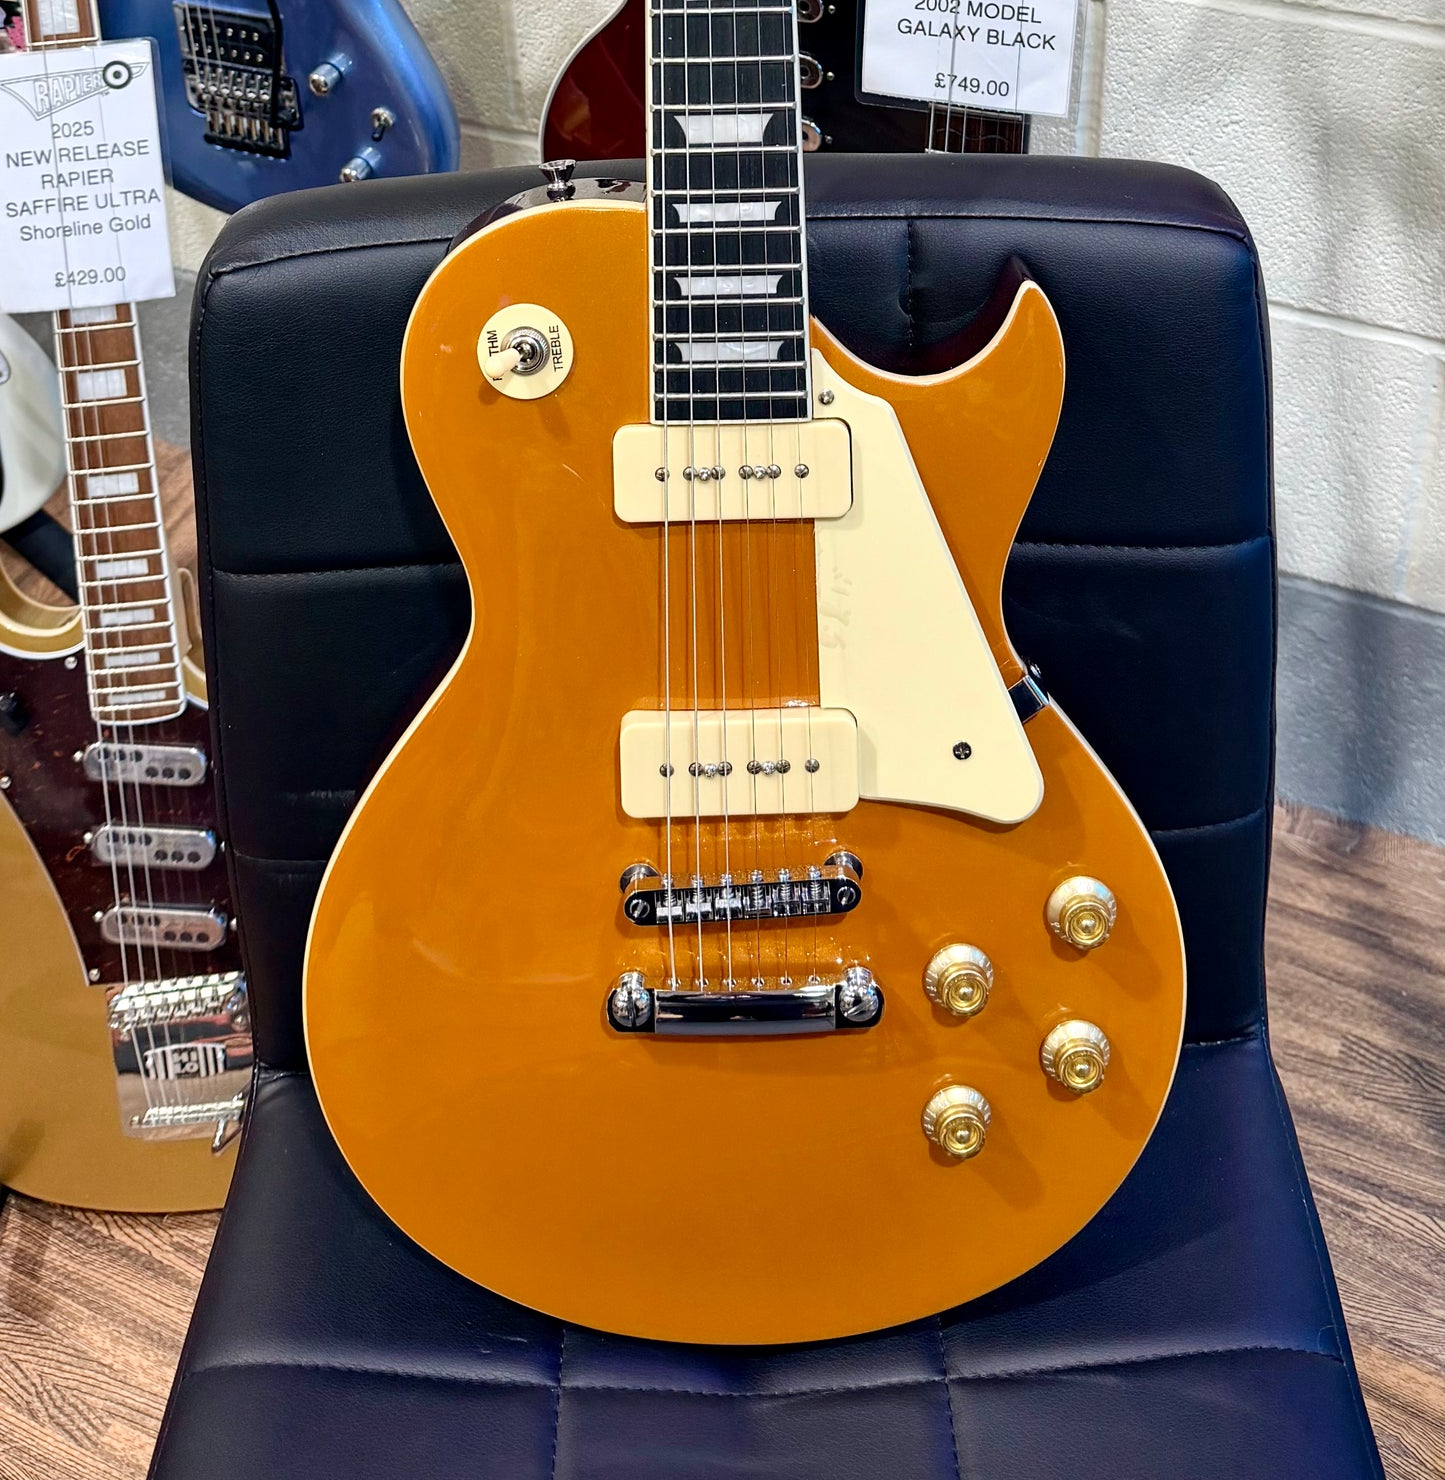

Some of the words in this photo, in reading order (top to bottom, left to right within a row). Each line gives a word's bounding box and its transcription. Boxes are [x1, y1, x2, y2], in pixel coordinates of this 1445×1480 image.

[967, 0, 1042, 24] MODEL
[897, 18, 980, 43] GALAXY
[986, 29, 1056, 50] BLACK
[33, 71, 104, 113] RAPIER
[935, 72, 1010, 97] £749.00
[52, 121, 95, 139] 2025
[6, 149, 52, 168] NEW
[58, 139, 150, 163] RELEASE
[41, 169, 114, 189] RAPIER
[6, 194, 89, 218] SAFFIRE
[95, 188, 161, 209] ULTRA
[20, 220, 104, 242] Shoreline
[109, 213, 151, 233] Gold
[55, 266, 127, 288] £429.00
[549, 324, 564, 372] TREBLE
